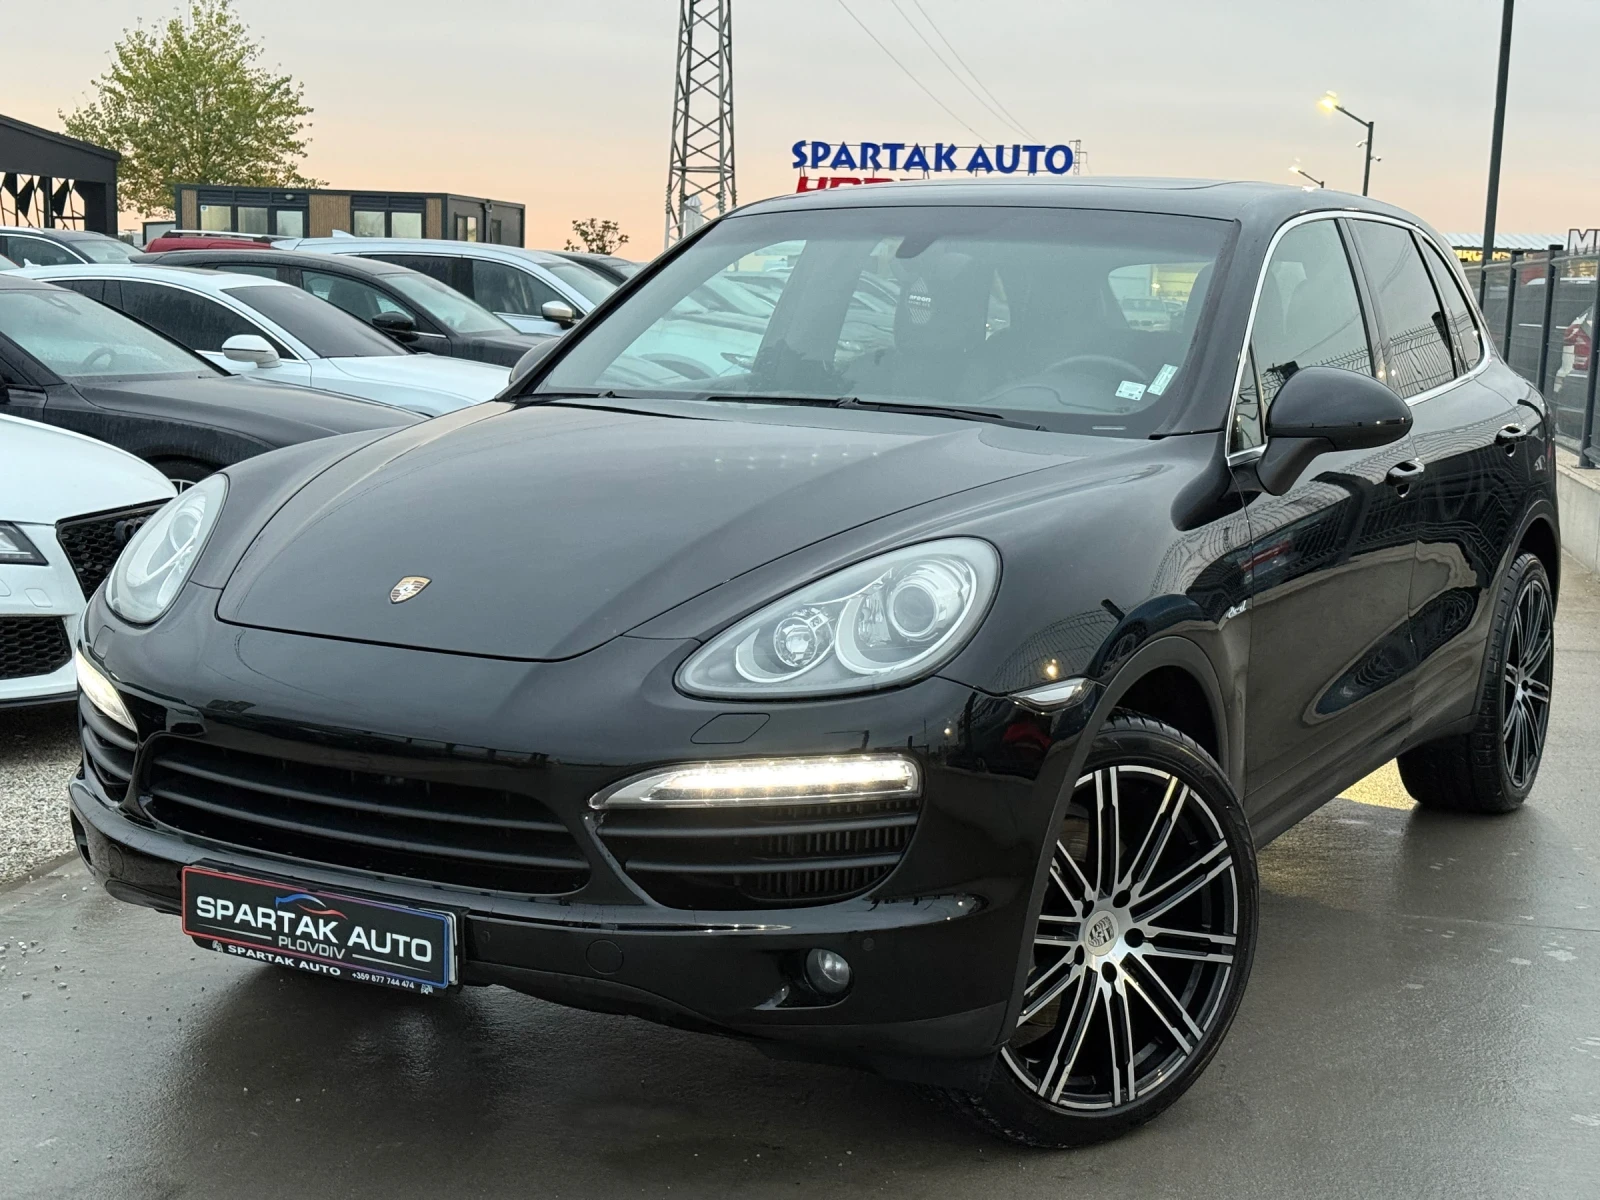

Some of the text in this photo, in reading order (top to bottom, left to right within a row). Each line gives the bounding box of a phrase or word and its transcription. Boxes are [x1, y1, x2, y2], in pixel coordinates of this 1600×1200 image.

[792, 140, 1074, 174] SPARTAK AUTO
[196, 896, 432, 963] SPARTAK AUTO
[278, 936, 345, 960] PLOVDIV
[228, 945, 415, 989] SPARTAK AUTO +359 877 744 474
